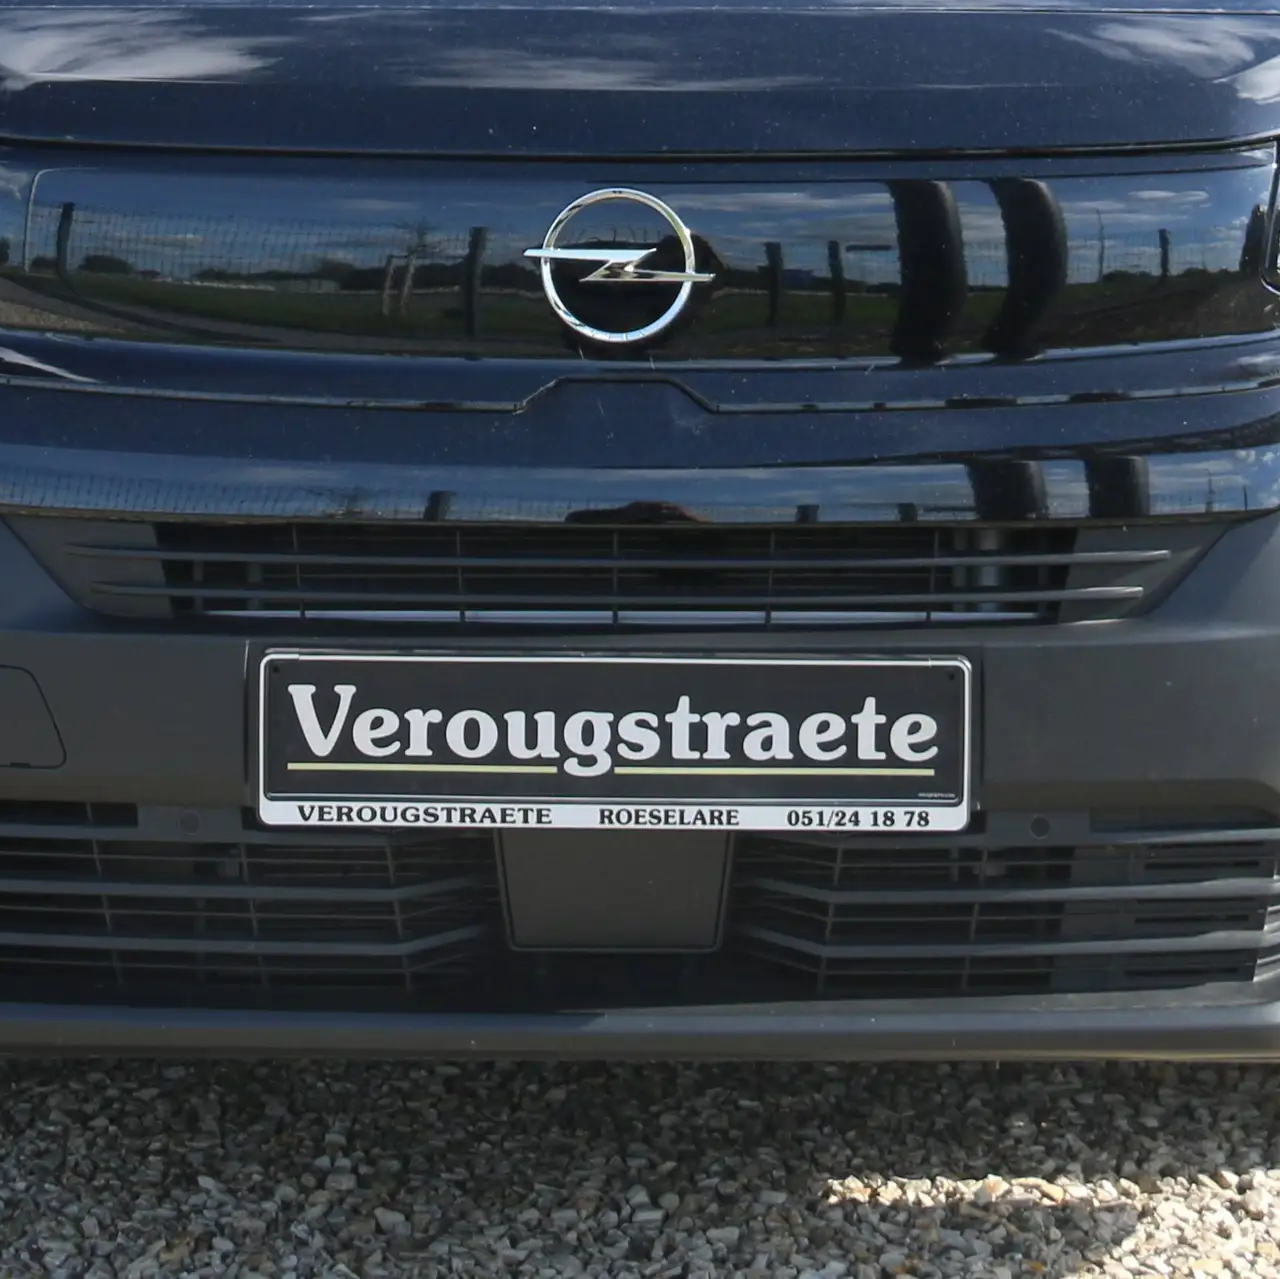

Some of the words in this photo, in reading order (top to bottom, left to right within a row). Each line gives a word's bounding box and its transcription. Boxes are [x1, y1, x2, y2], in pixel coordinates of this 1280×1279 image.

[287, 683, 939, 777] Verougstraete
[296, 804, 553, 825] VEROUGSTRAETE
[598, 807, 740, 827] ROESELARE
[786, 809, 861, 828] 051/24
[869, 809, 896, 828] 18
[904, 810, 931, 828] 78
